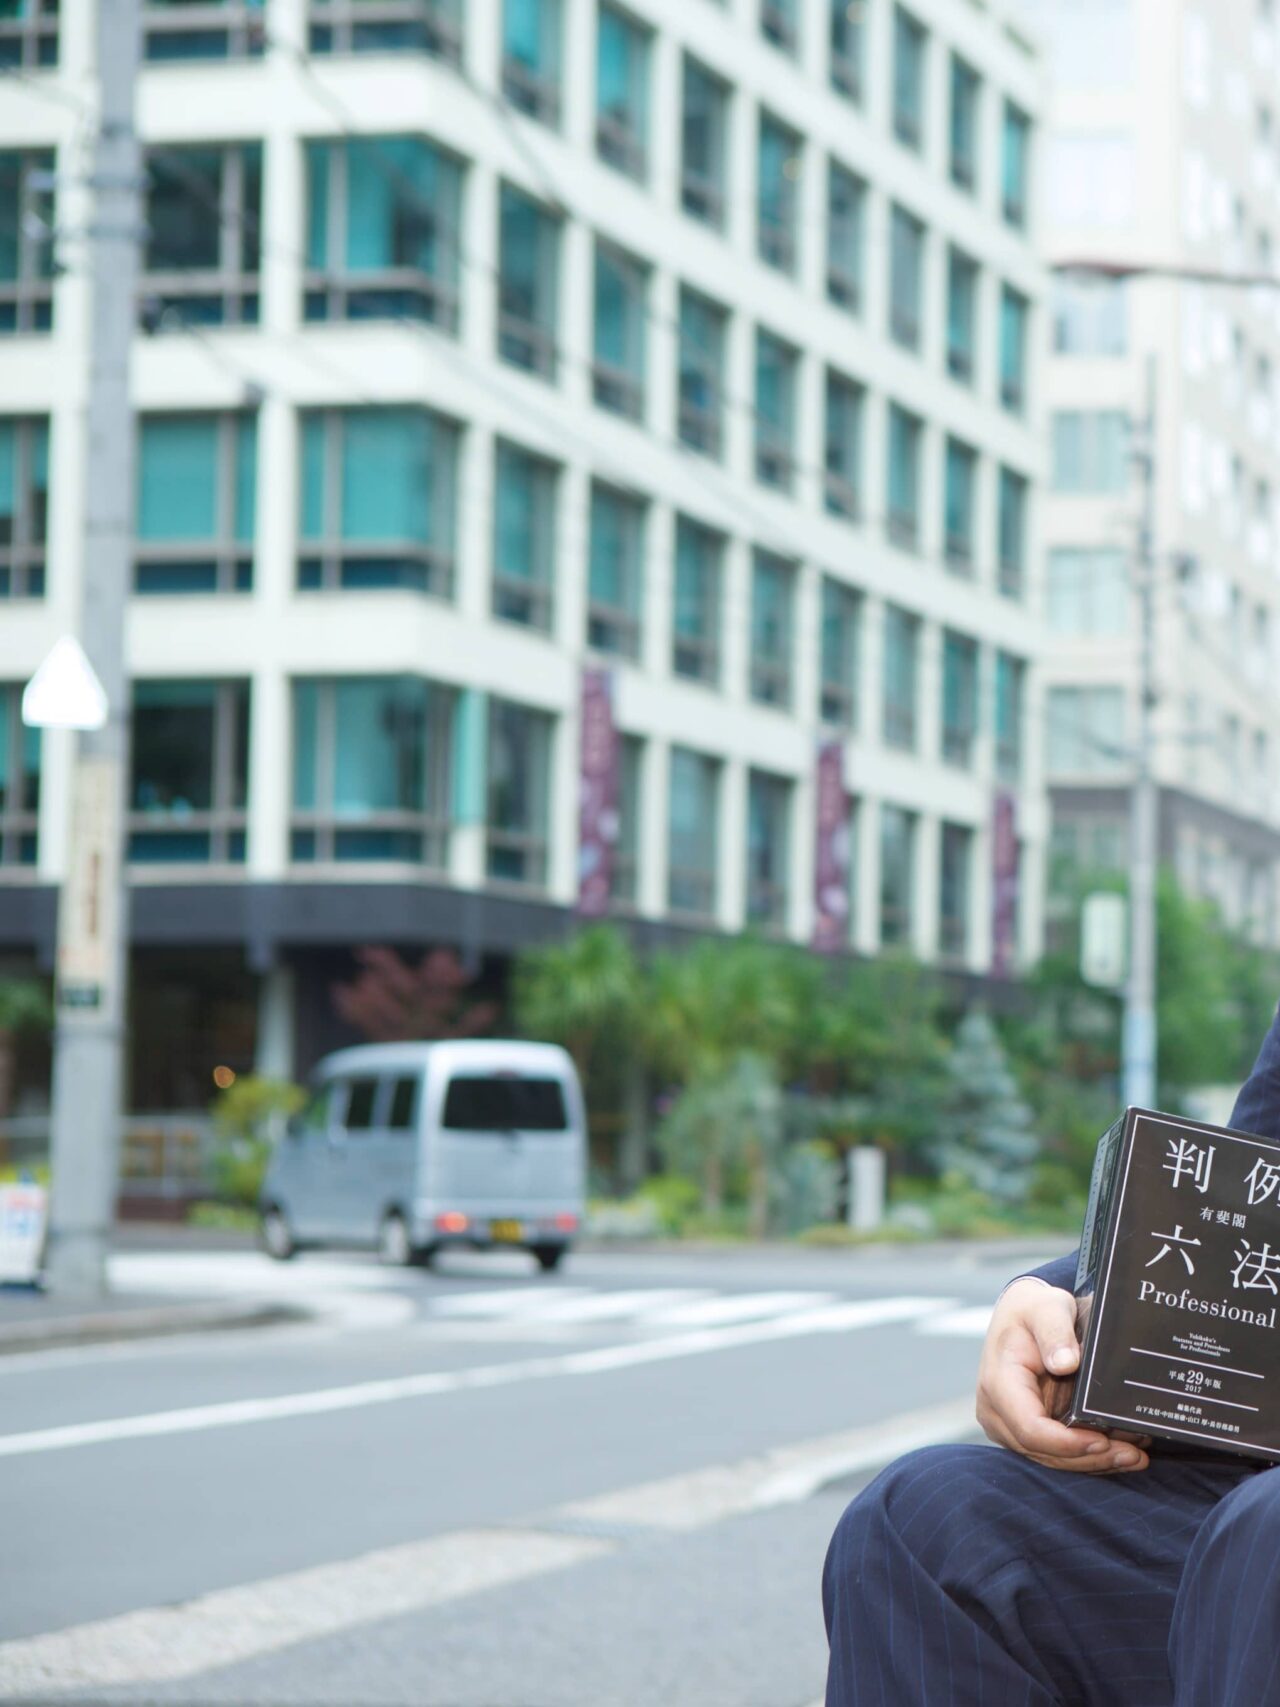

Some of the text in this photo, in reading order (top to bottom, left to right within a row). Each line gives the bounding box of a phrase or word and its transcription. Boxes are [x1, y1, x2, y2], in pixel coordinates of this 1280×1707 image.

[1199, 1206, 1247, 1229] 有斐閣
[1137, 1280, 1276, 1329] Professional
[1168, 1369, 1222, 1390] 平成29年版
[1185, 1384, 1202, 1394] 2017
